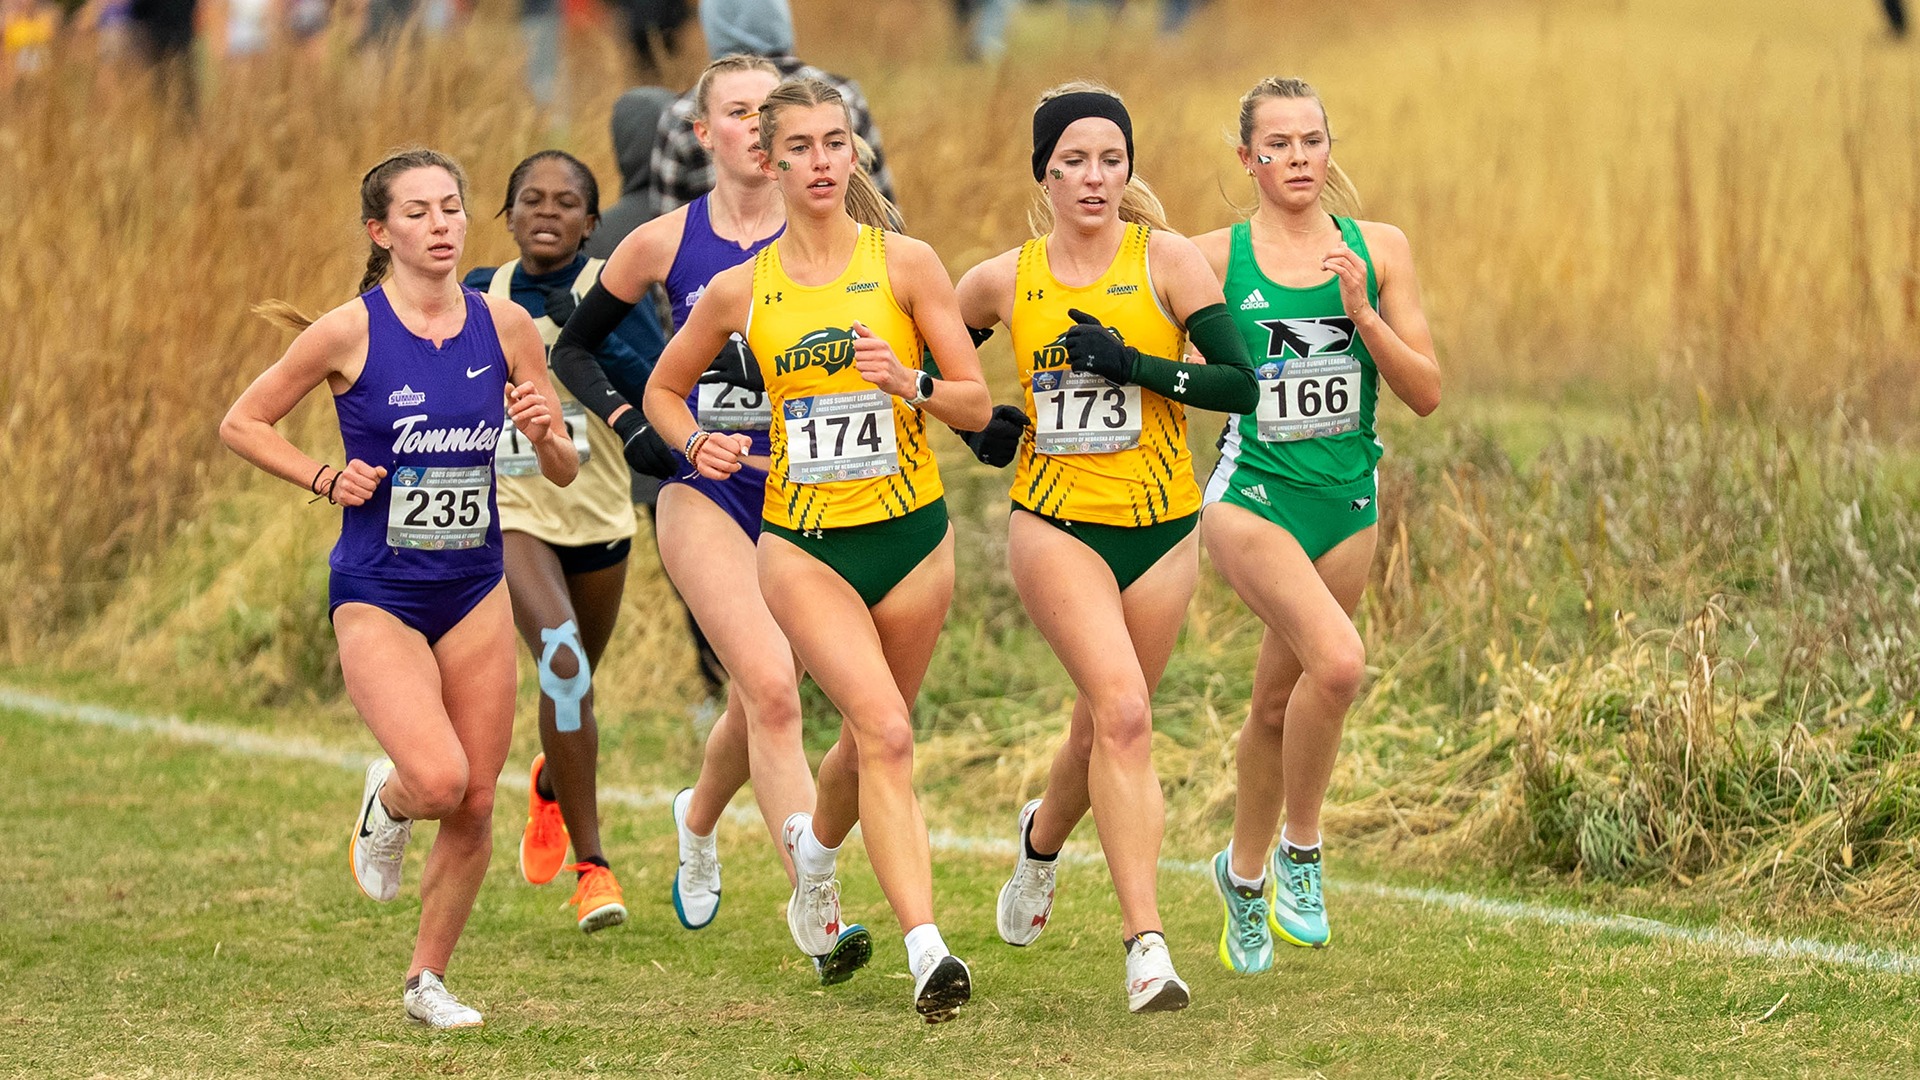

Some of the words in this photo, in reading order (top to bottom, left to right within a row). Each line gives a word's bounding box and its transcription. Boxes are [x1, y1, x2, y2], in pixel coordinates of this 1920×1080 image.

[846, 282, 879, 293] SUMMIT
[1107, 284, 1138, 295] SUMMIT
[1240, 301, 1270, 310] adidas
[775, 341, 848, 377] NDSU
[1033, 347, 1071, 370] ND
[1306, 360, 1327, 368] SUMMIT
[390, 394, 424, 403] SUMMIT
[819, 398, 834, 406] 2025
[834, 396, 856, 404] SUMMIT
[858, 393, 876, 402] LEAGUE
[850, 400, 884, 410] CHAMPIONSHIPS
[1270, 376, 1348, 418] 166
[1050, 388, 1127, 430] 173
[392, 414, 499, 454] Tommies
[801, 412, 882, 458] 174
[1240, 488, 1271, 506] adidas
[403, 489, 480, 528] 235
